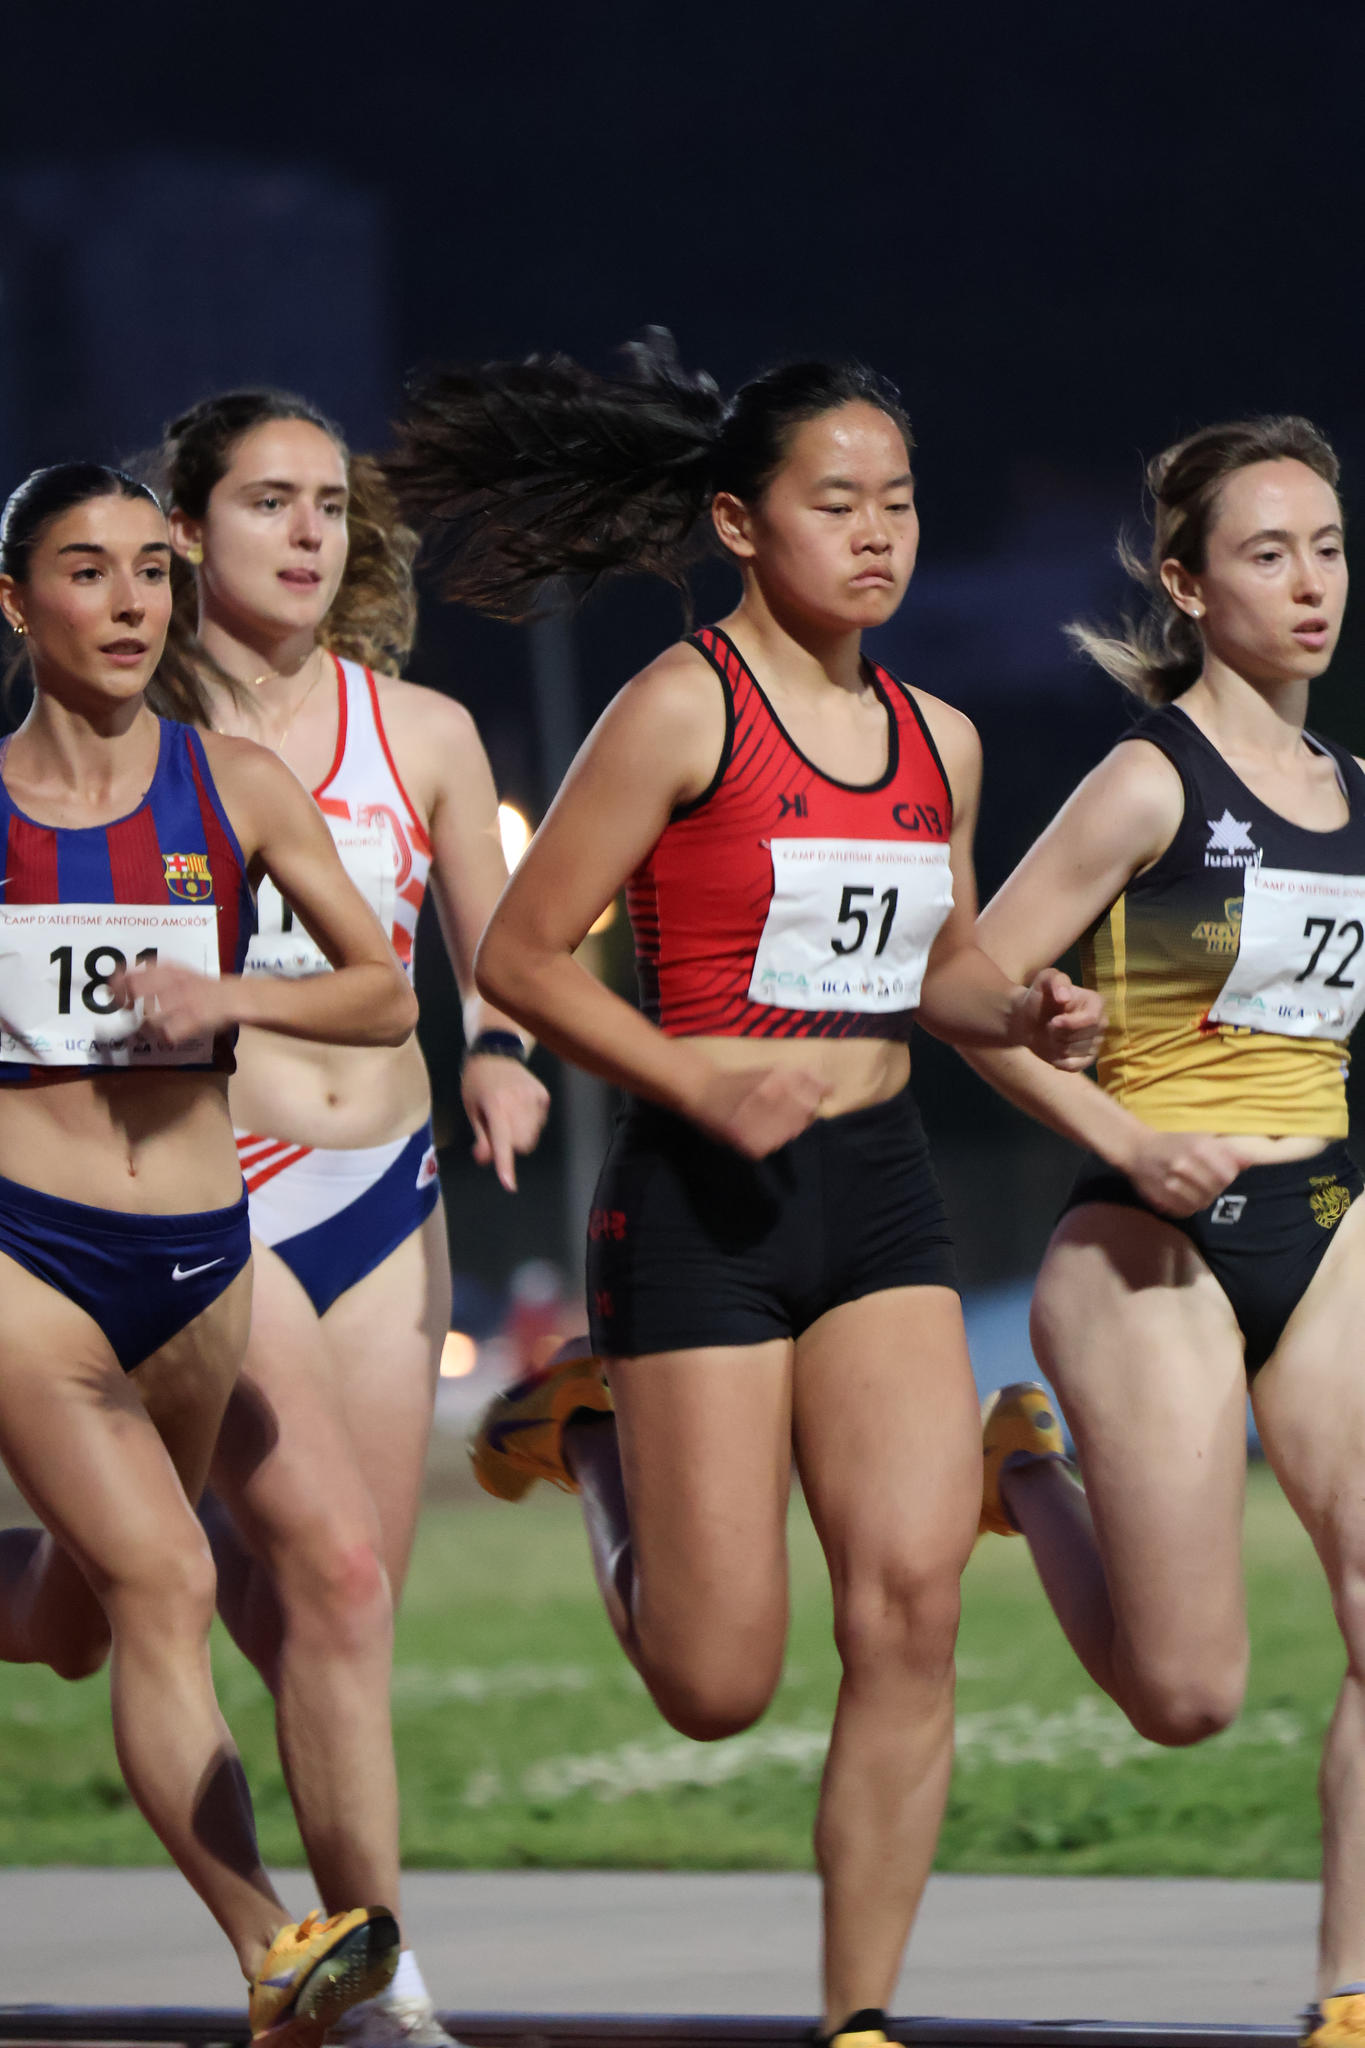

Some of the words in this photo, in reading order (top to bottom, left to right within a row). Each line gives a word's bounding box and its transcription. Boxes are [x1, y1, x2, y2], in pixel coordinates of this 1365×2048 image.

[4, 915, 36, 925] CAMP
[38, 915, 101, 926] D'ATLETISME
[105, 915, 159, 927] ANTONIO
[161, 915, 208, 927] AMORÓS
[830, 885, 899, 957] 51
[1294, 917, 1365, 989] 72
